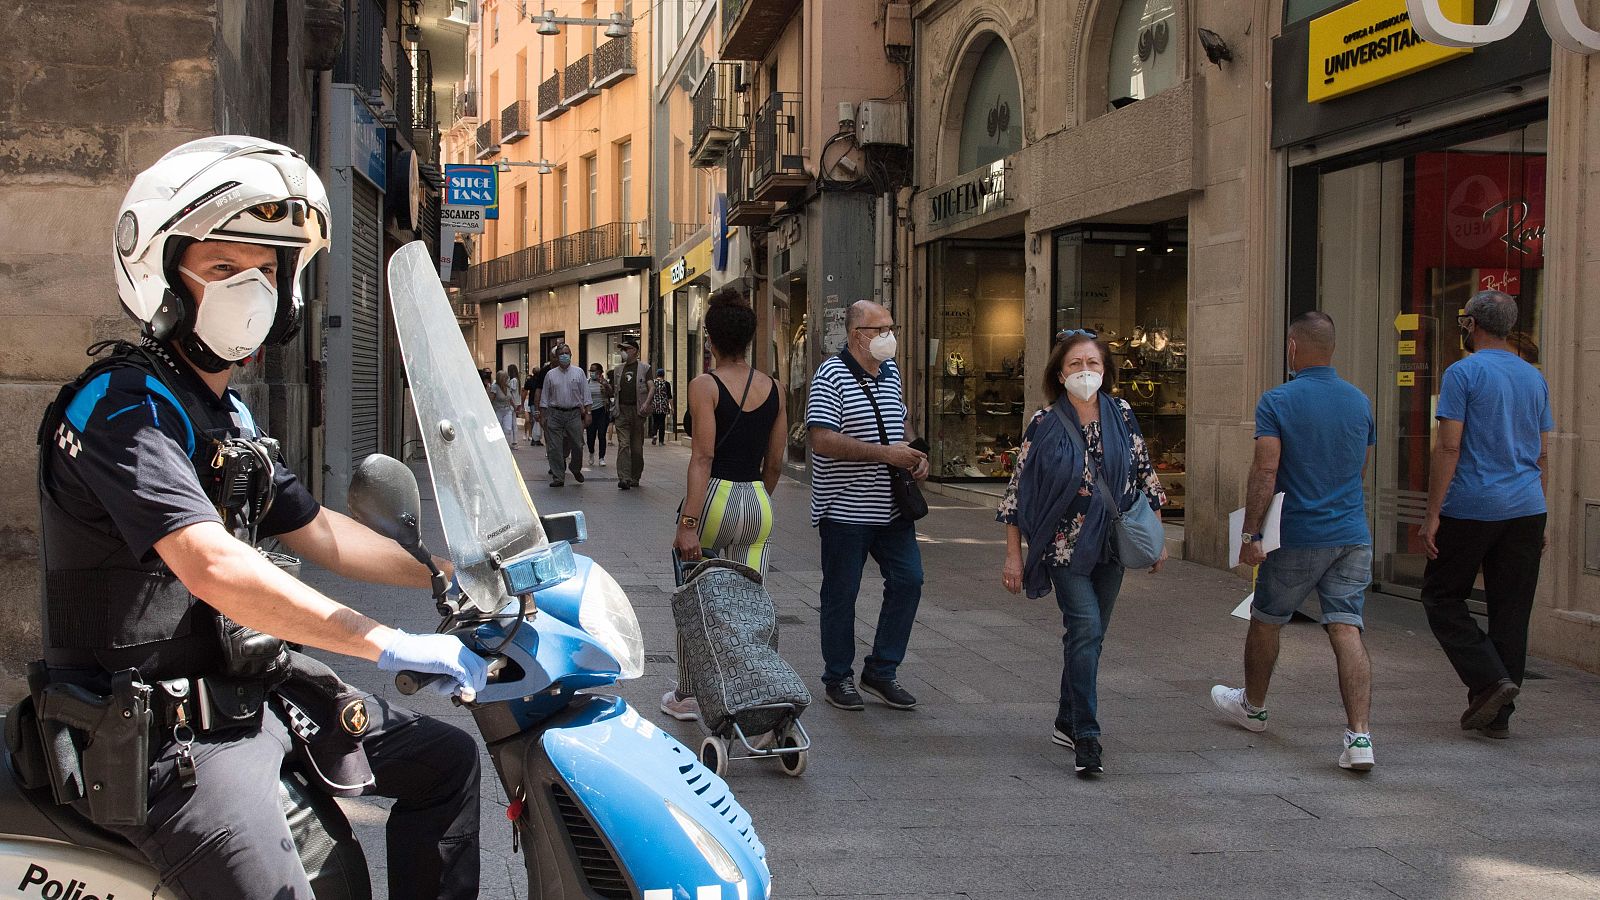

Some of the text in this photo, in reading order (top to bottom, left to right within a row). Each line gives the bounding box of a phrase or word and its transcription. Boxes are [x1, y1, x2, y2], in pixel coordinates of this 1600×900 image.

[1325, 27, 1426, 76] UNIVERSITAR
[451, 176, 492, 189] SITGE
[452, 189, 493, 201] TANA
